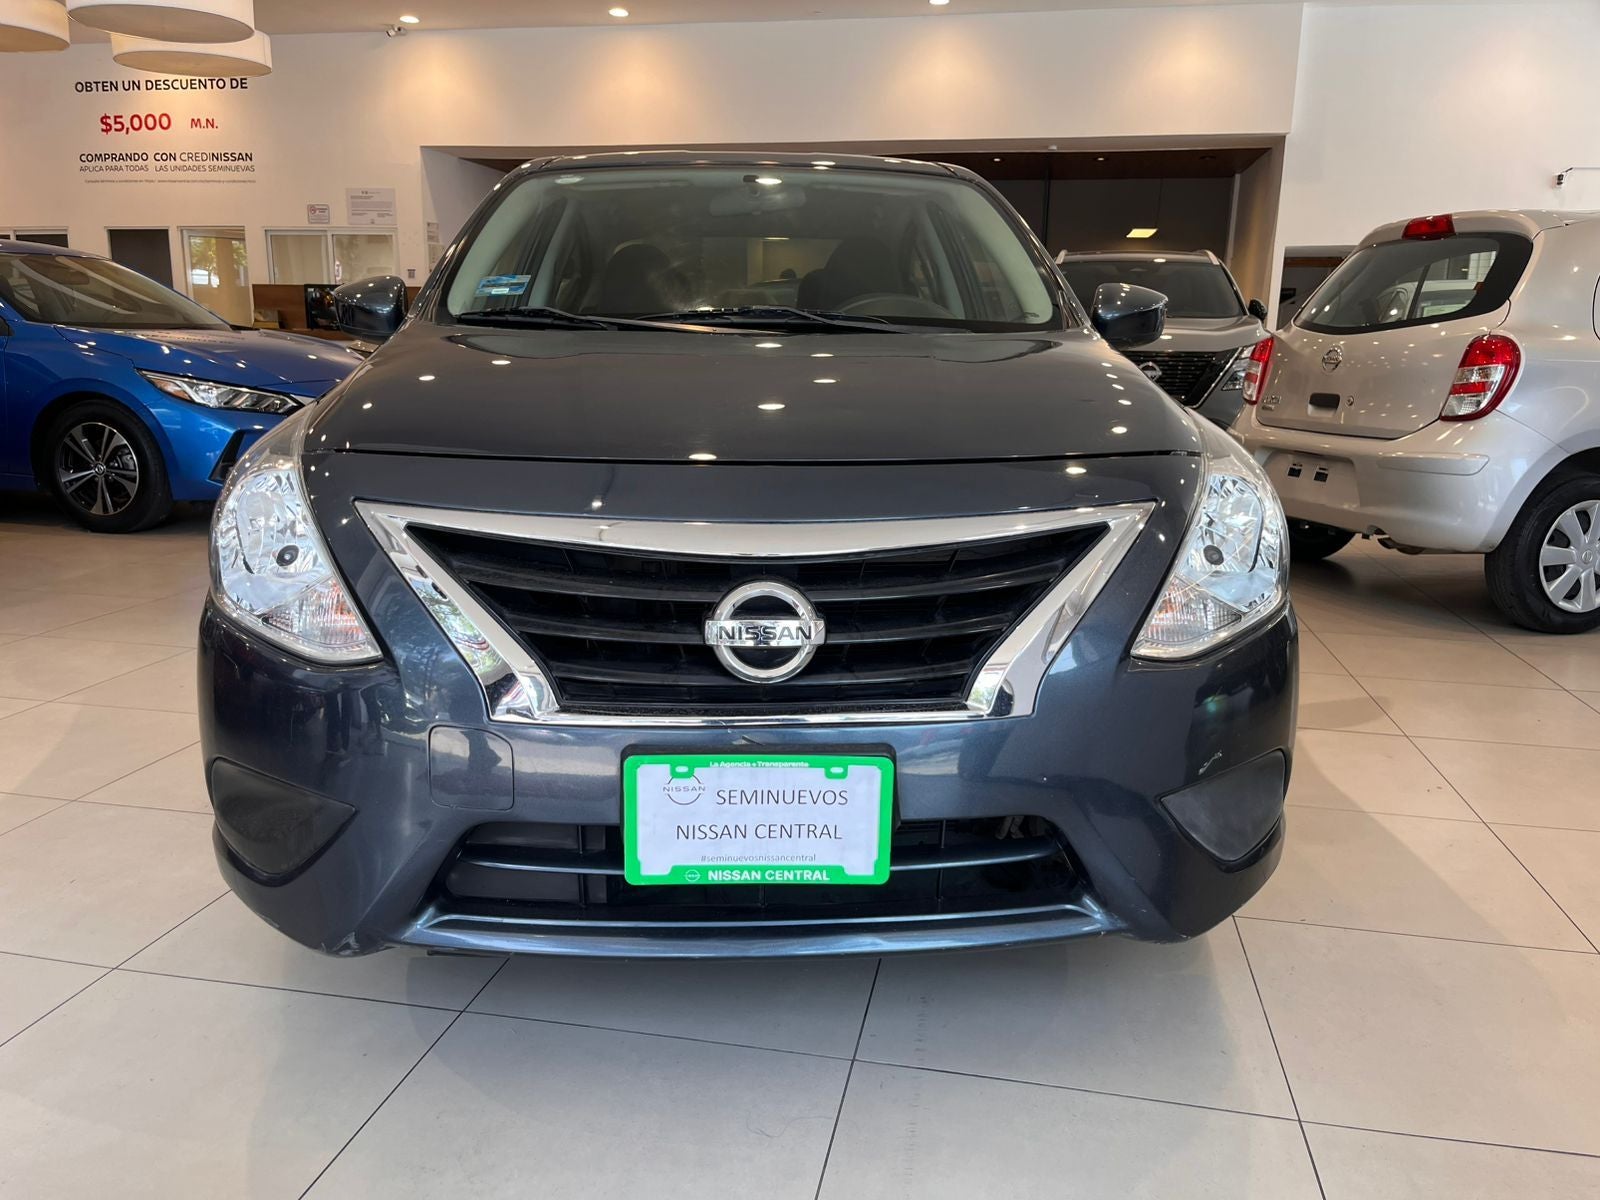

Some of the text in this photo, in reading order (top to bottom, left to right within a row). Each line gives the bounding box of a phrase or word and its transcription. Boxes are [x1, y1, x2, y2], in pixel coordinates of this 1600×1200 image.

[74, 77, 249, 93] OBTEN UN DESCUENTO DE
[100, 112, 219, 135] $5,000 M.N.
[79, 151, 253, 163] COMPRANDO CON CREDINISSAN
[79, 165, 104, 173] APLICA
[125, 164, 149, 172] TODAS
[154, 164, 169, 172] LAS
[169, 164, 207, 172] UNIDADES
[208, 164, 255, 173] SEMINUEVAS
[718, 625, 812, 641] NISSAN
[662, 785, 706, 793] NISSAN
[715, 789, 849, 806] SEMINUEVOS
[676, 823, 843, 840] NISSAN CENTRAL
[700, 853, 816, 863] #seminuevosnissancentral
[708, 869, 761, 881] NISSAN
[764, 869, 830, 881] CENTRAL
